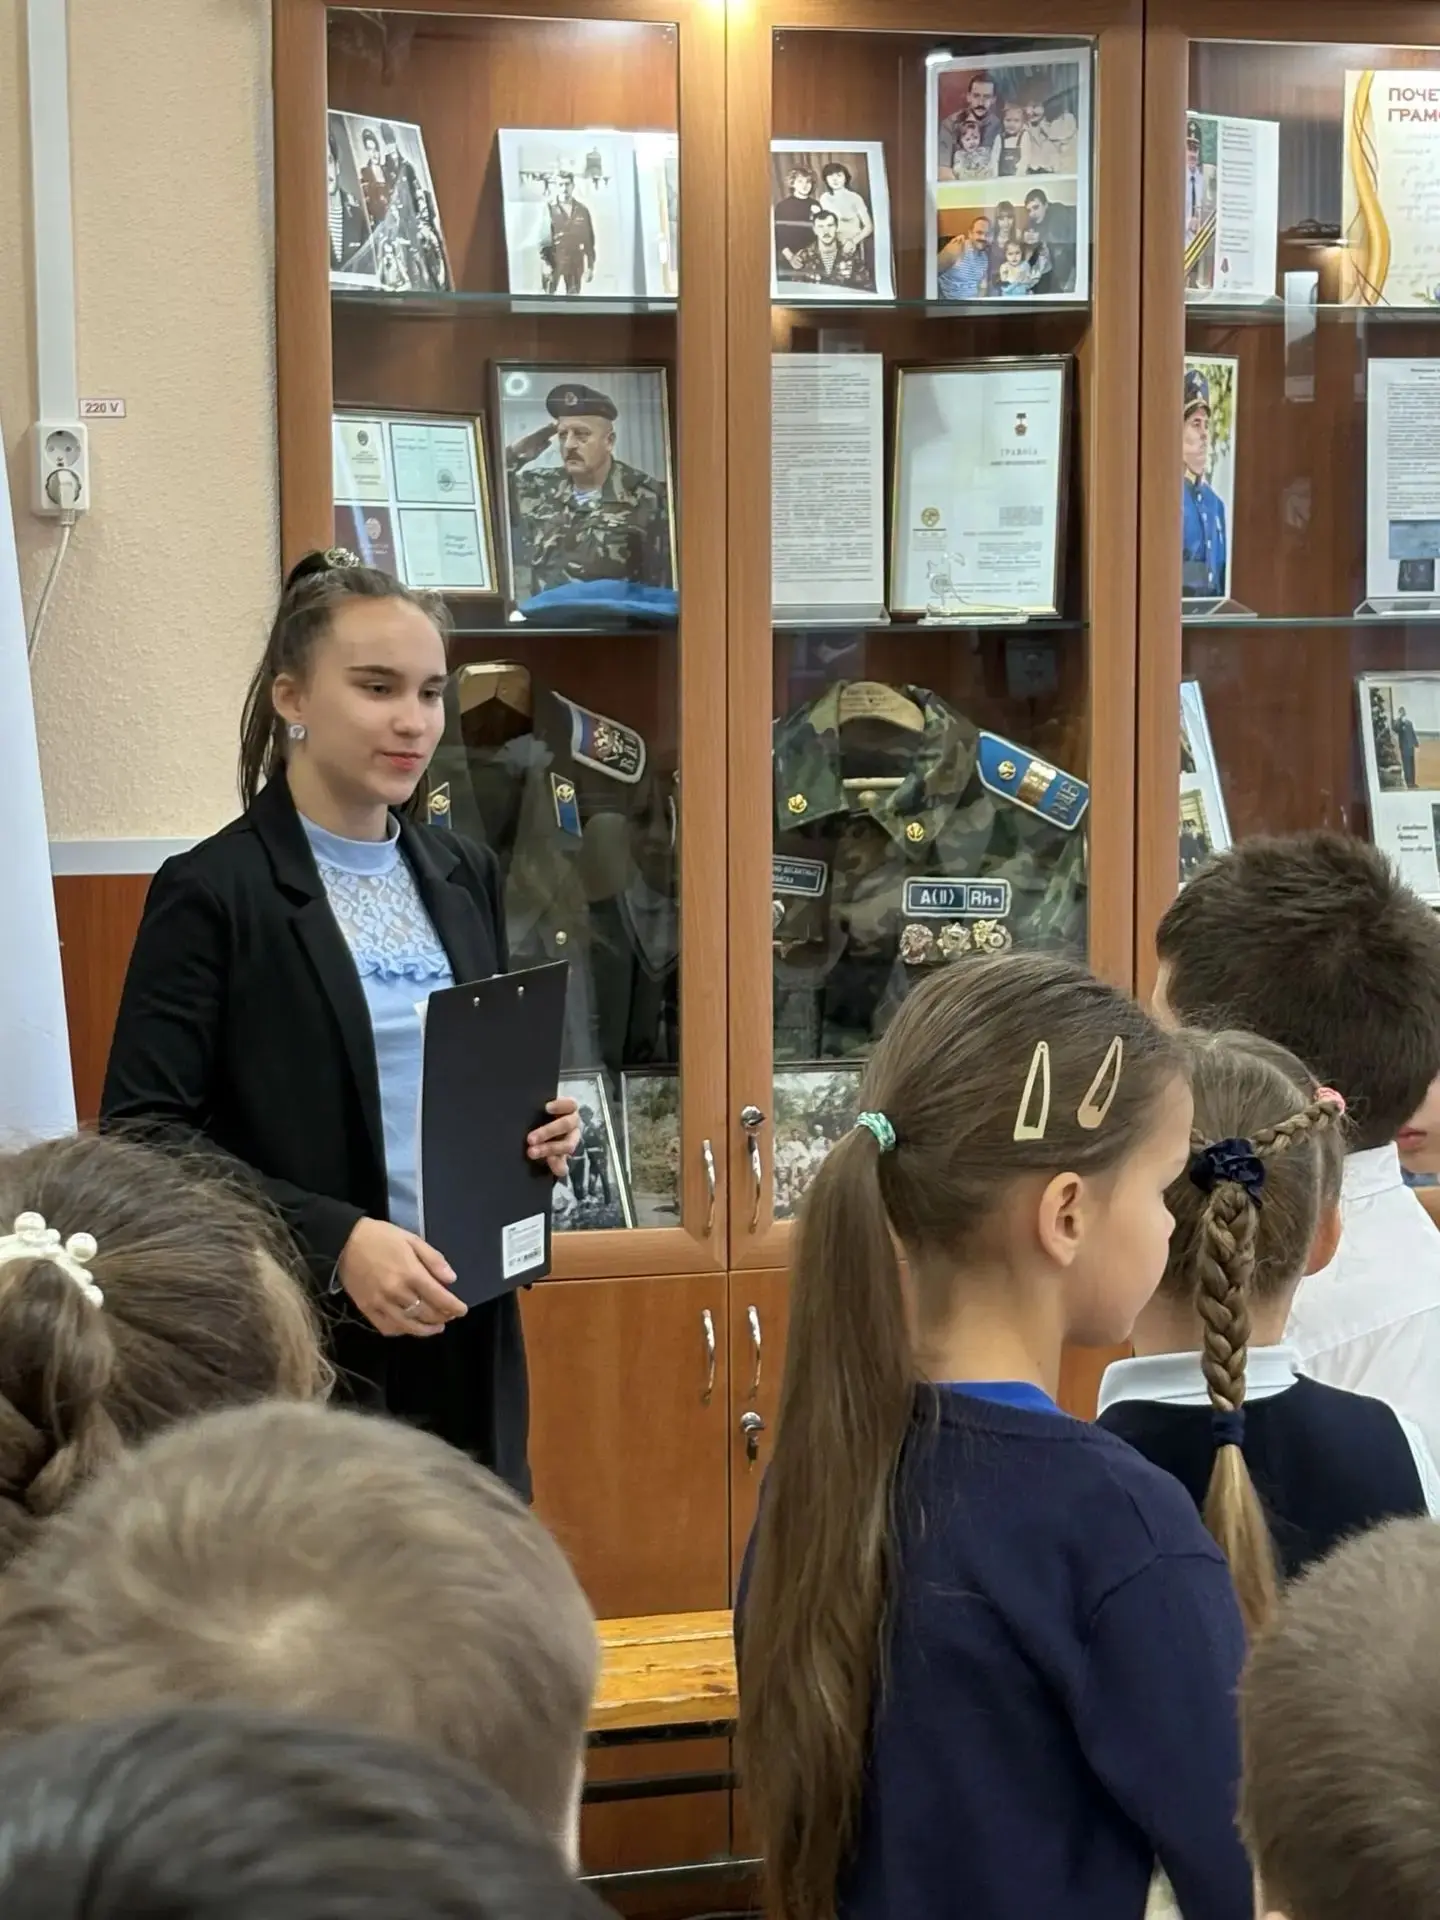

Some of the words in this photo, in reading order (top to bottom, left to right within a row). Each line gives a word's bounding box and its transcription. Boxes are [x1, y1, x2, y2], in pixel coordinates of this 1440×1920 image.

[1388, 87, 1440, 102] ПОЧЕ
[1388, 108, 1440, 122] ГРАМ
[85, 402, 107, 413] 220
[110, 402, 120, 413] V
